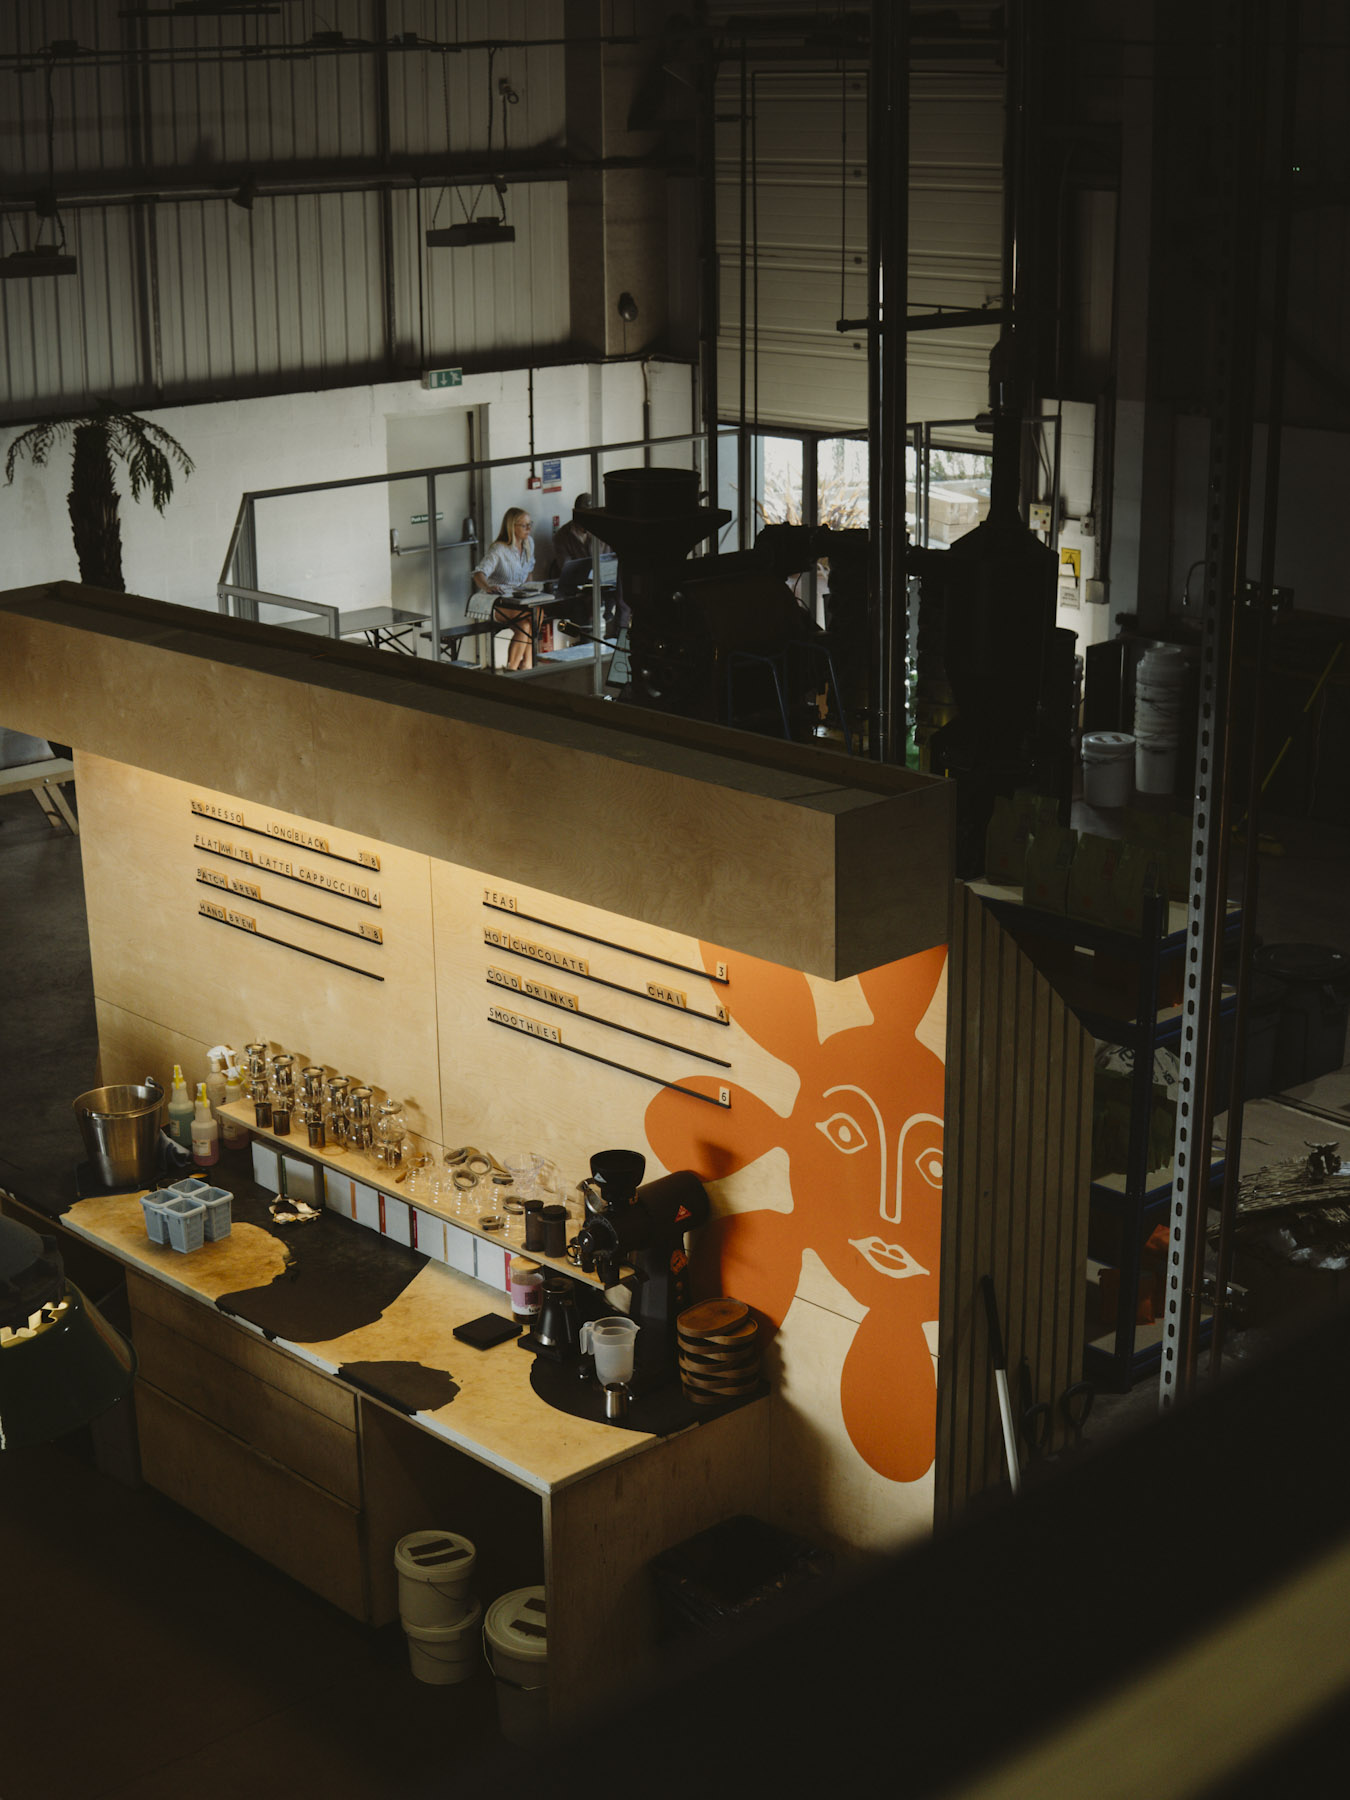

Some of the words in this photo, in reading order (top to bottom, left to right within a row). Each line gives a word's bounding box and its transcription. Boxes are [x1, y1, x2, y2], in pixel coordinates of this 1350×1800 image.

[192, 801, 242, 823] ESPRESSO
[197, 868, 225, 886] BATCH
[233, 882, 258, 898] BREW
[259, 856, 290, 874] LATTE
[299, 869, 367, 899] CAPPUCCINO
[372, 893, 378, 903] 4
[200, 903, 224, 919] HAND
[229, 914, 254, 930] BREW
[484, 891, 514, 909] TEAS
[718, 966, 724, 977] 3
[487, 969, 519, 988] COLD
[526, 984, 574, 1008] DRINKS
[648, 986, 681, 1005] CHAI
[718, 1009, 725, 1020] 4
[489, 1007, 557, 1040] SMOOTHIES
[721, 1092, 727, 1103] 6
